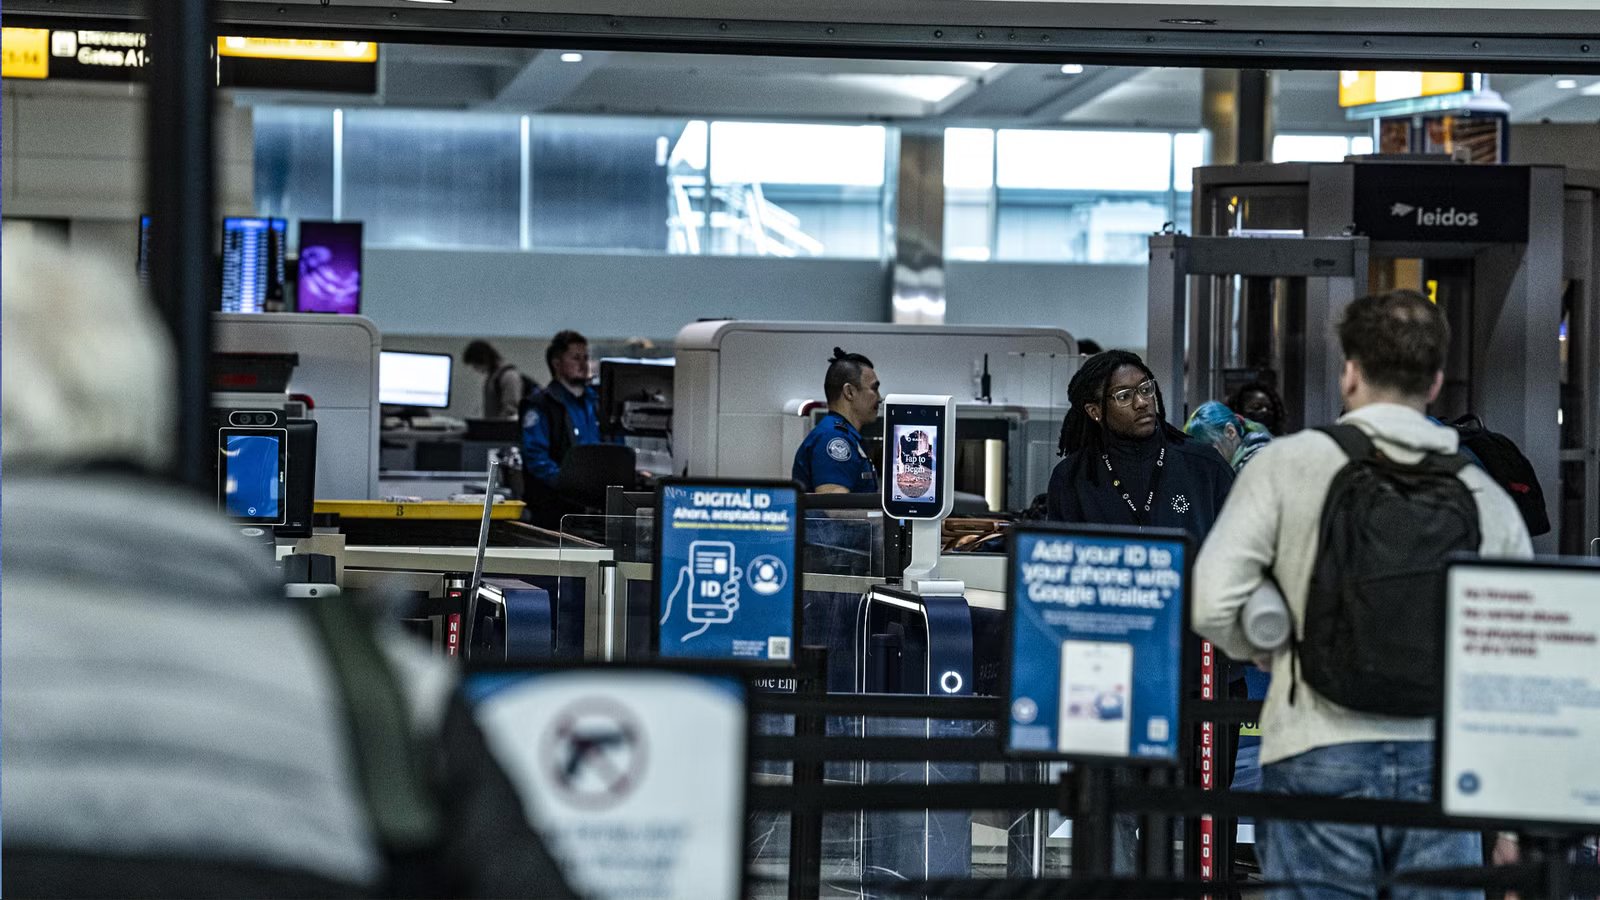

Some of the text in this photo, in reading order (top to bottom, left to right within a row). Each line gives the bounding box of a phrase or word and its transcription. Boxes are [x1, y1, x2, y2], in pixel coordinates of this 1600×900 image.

[1417, 207, 1479, 226] leidos
[904, 455, 926, 464] Tap to
[693, 491, 752, 509] DIGITAL
[753, 493, 771, 509] ID
[1032, 540, 1172, 568] Add your ID to
[1022, 563, 1180, 588] your phone with
[700, 580, 720, 597] ID
[1028, 582, 1097, 608] Google
[444, 622, 457, 656] NOT
[1202, 642, 1211, 699] DO NO
[1202, 721, 1211, 790] REMOV
[1202, 833, 1210, 858] DO
